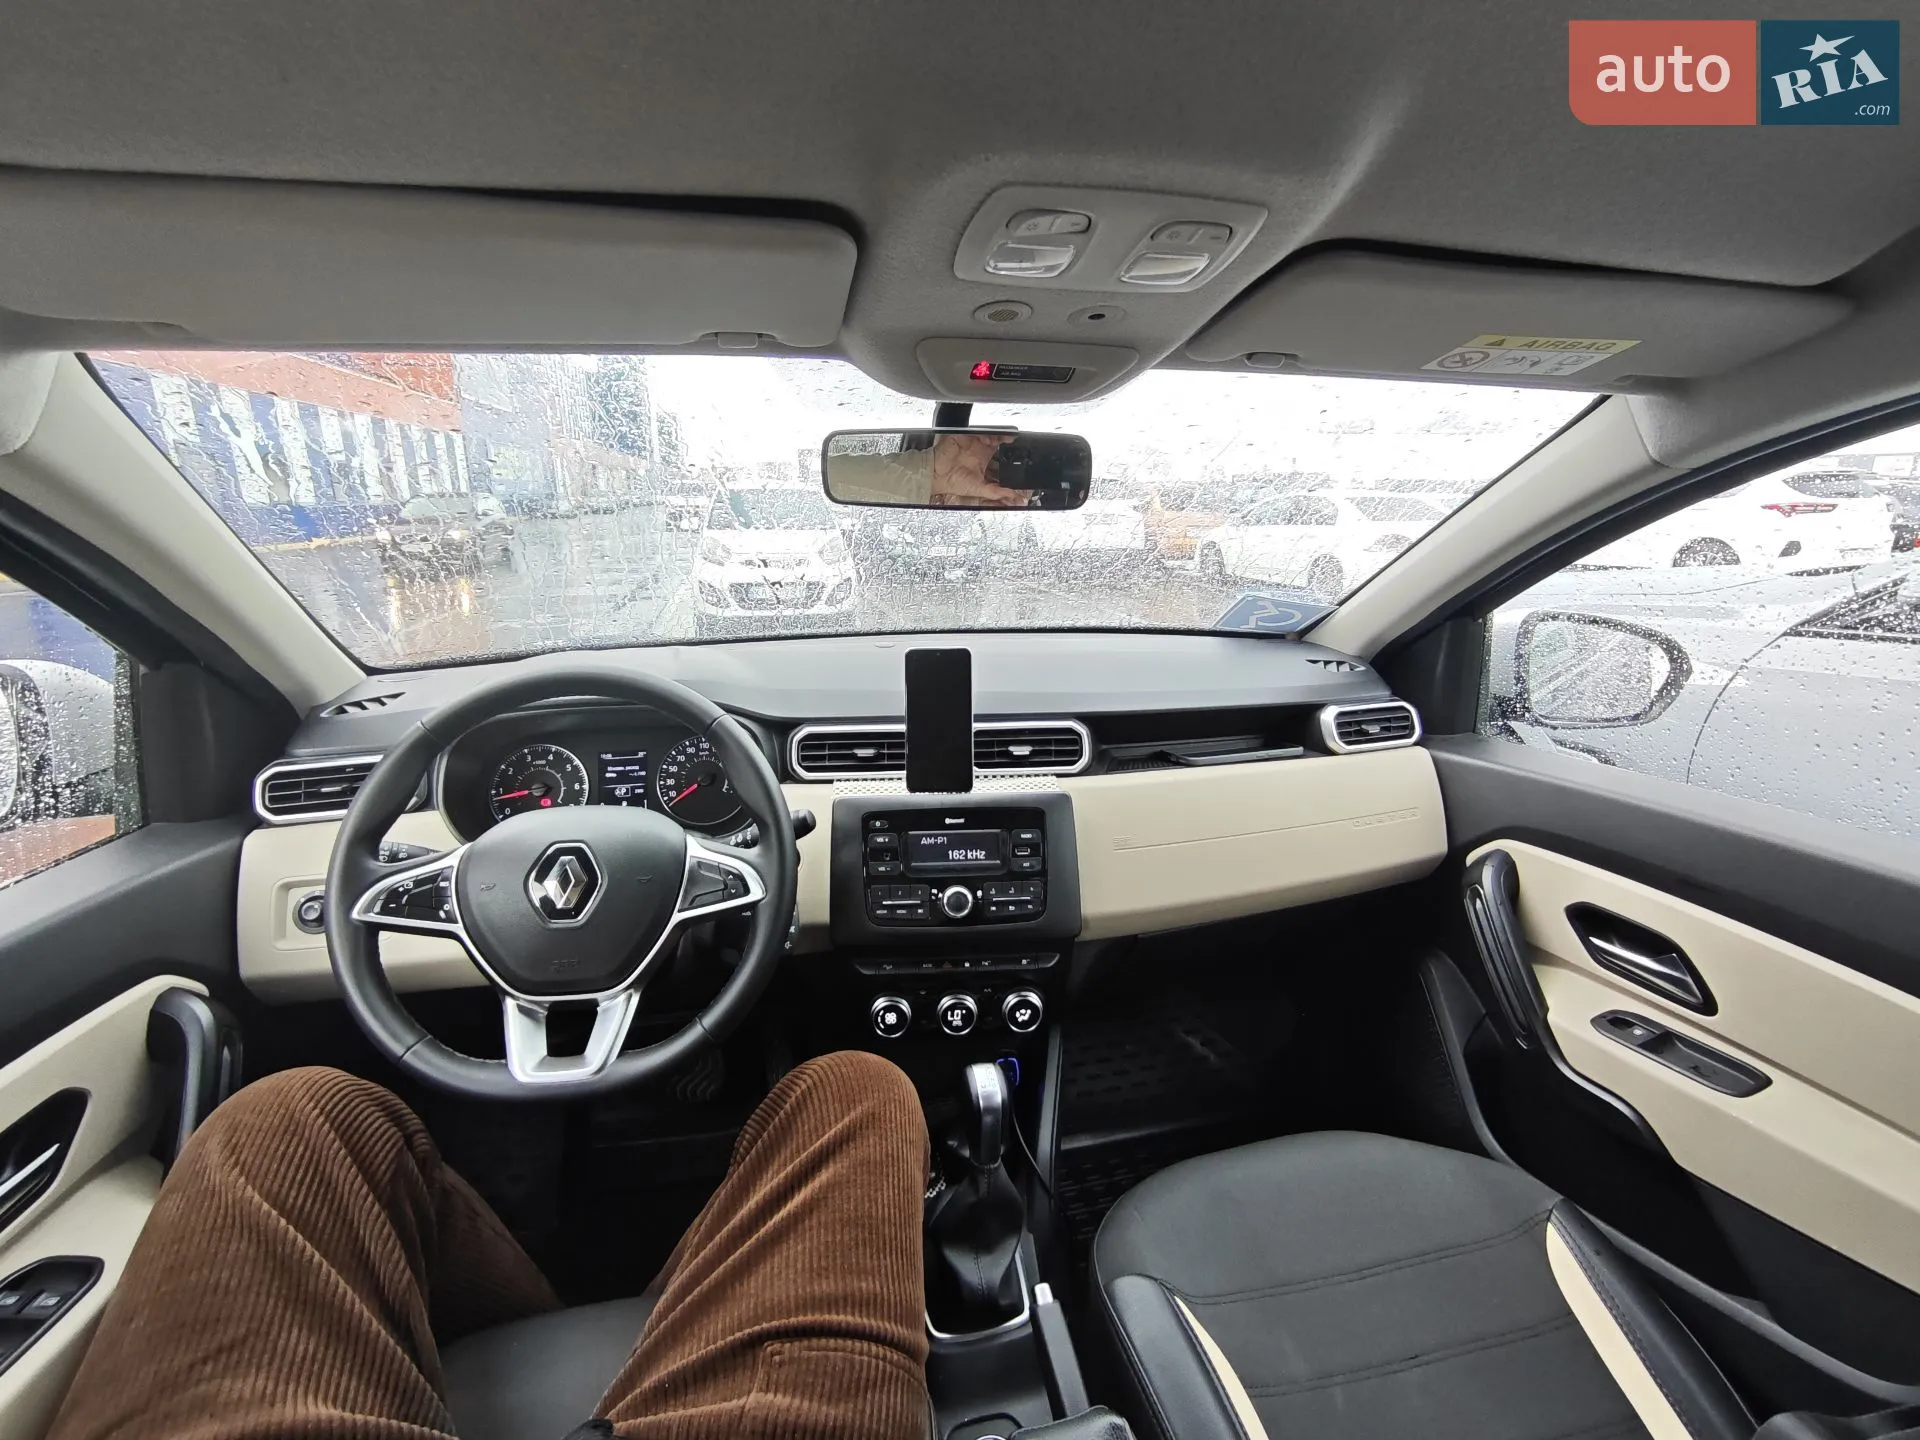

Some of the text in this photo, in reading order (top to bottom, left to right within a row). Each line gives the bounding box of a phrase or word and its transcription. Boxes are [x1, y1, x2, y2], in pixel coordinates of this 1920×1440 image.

[1518, 339, 1617, 351] AIRBAG
[526, 754, 532, 762] 3
[676, 754, 686, 762] 70
[508, 767, 514, 775] 2
[566, 764, 572, 772] 5
[668, 765, 678, 773] 50
[574, 782, 580, 790] 6
[666, 778, 675, 786] 30
[504, 807, 511, 815] 0
[920, 836, 948, 845] AM-P1
[947, 848, 986, 860] 162 kHz
